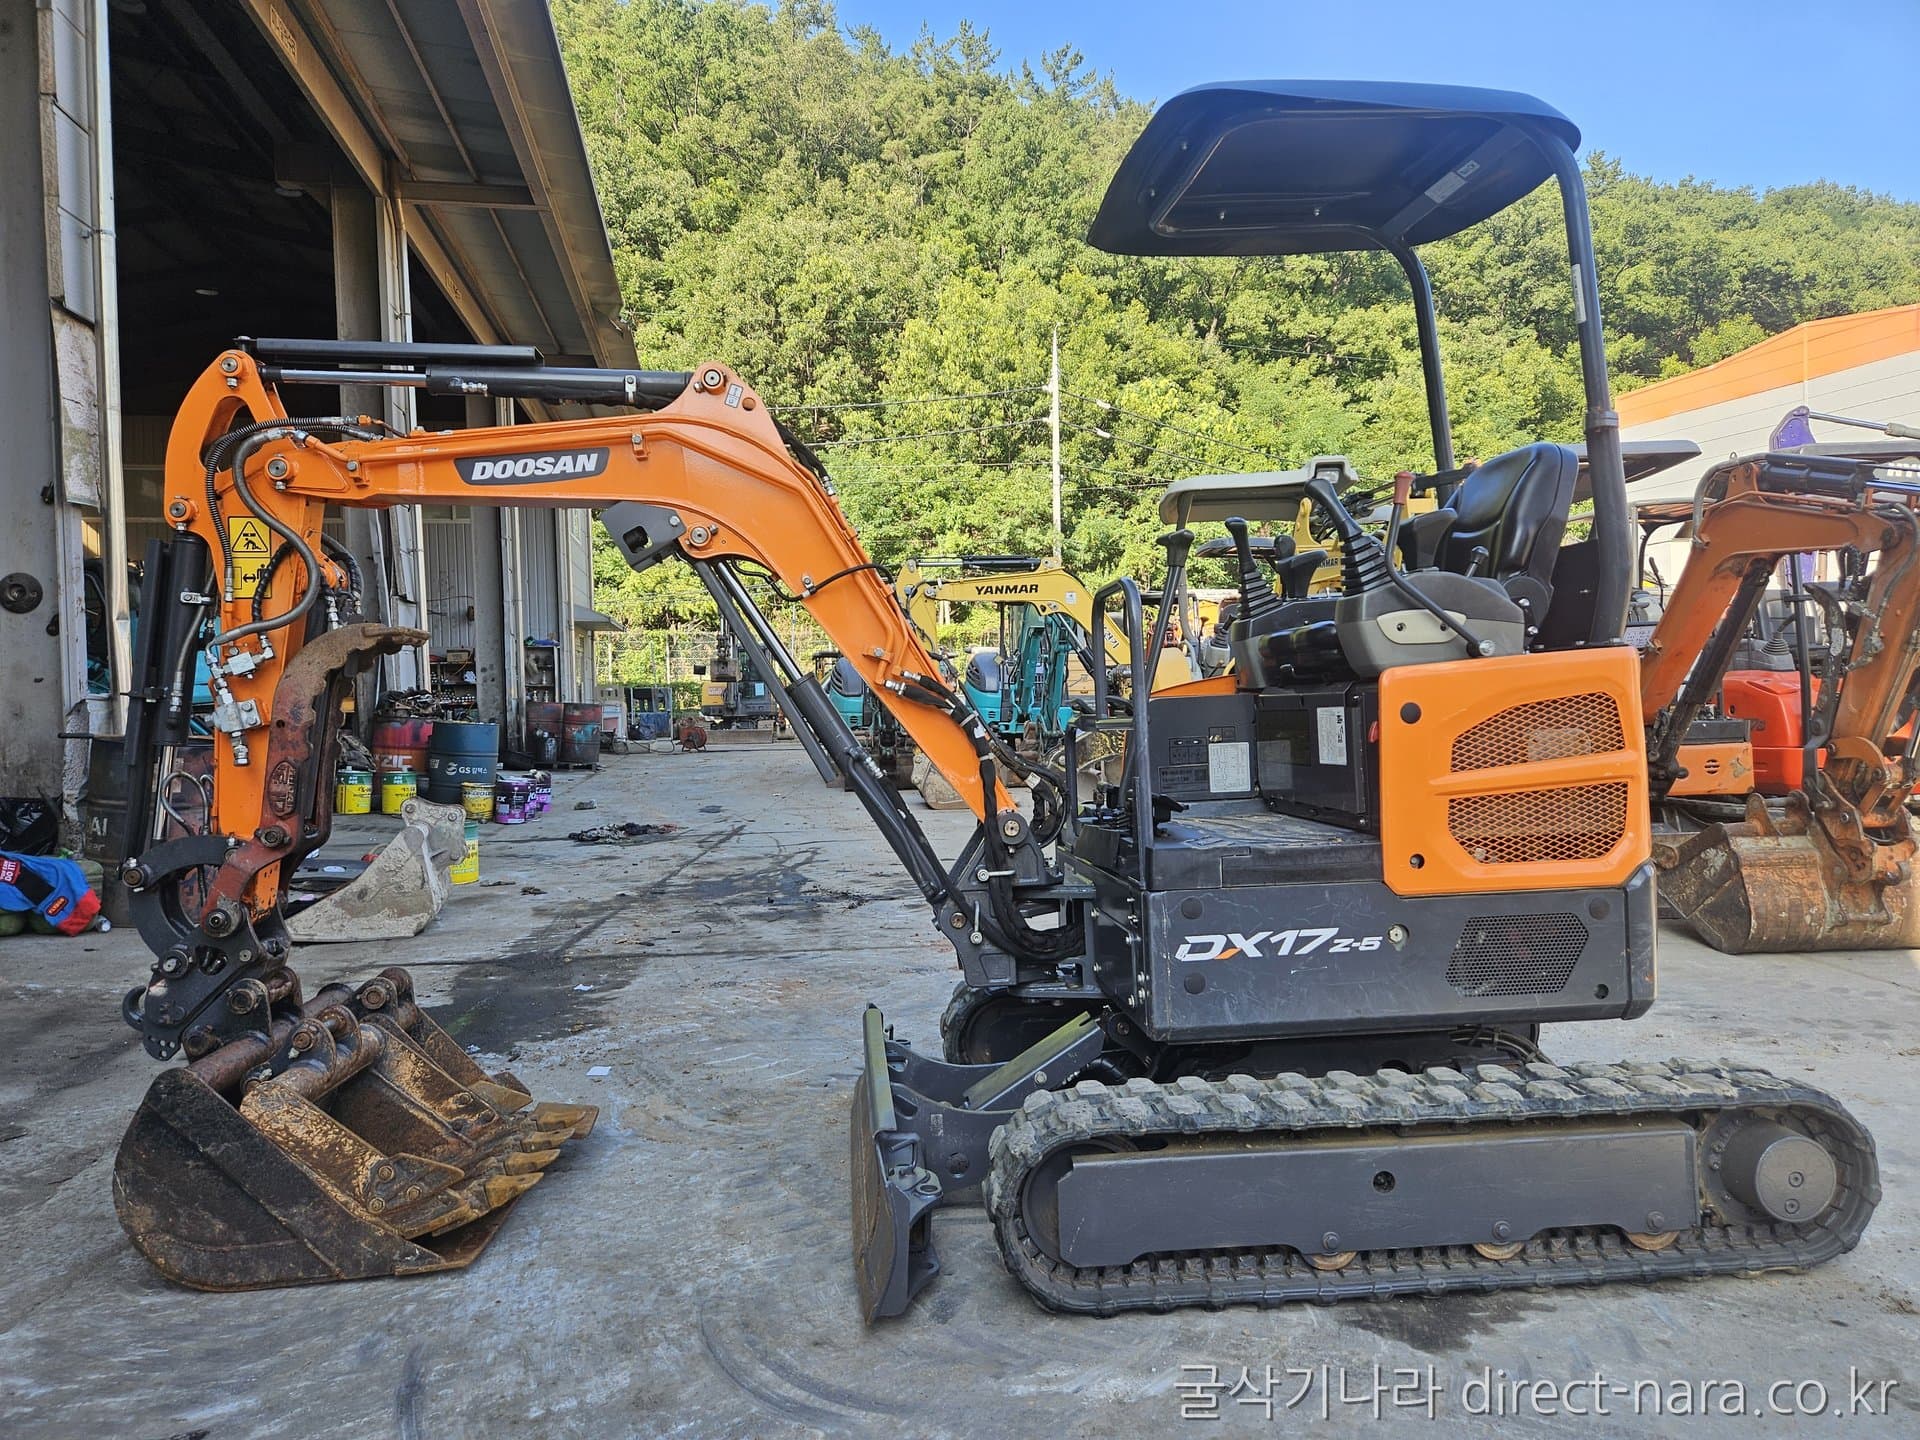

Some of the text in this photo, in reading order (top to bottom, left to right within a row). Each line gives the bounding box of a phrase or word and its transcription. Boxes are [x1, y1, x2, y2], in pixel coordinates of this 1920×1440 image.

[471, 453, 598, 480] DOOSAN
[975, 583, 1039, 596] YANMAR
[458, 766, 471, 775] GS
